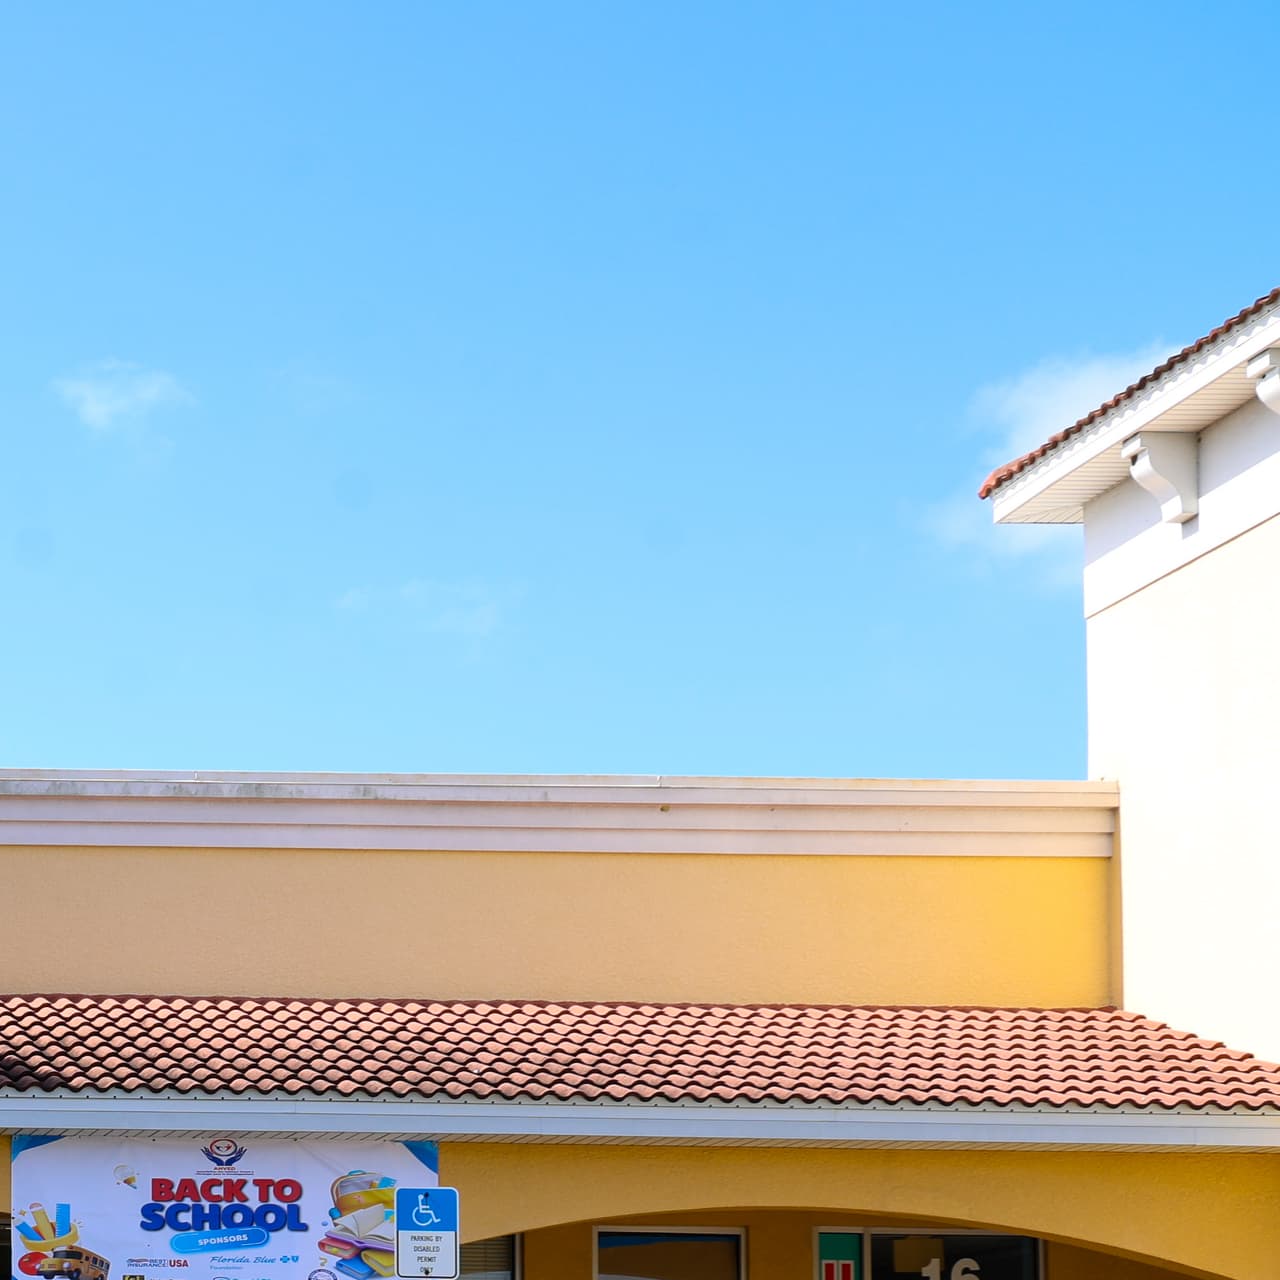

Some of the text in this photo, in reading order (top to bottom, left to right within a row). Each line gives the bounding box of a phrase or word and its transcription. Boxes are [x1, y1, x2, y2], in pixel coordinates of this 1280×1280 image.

[151, 1178, 303, 1203] BACK TO
[140, 1202, 310, 1233] SCHOOL
[197, 1234, 249, 1246] SPONSORS
[168, 1259, 190, 1268] USA
[209, 1255, 277, 1264] Florida Blue
